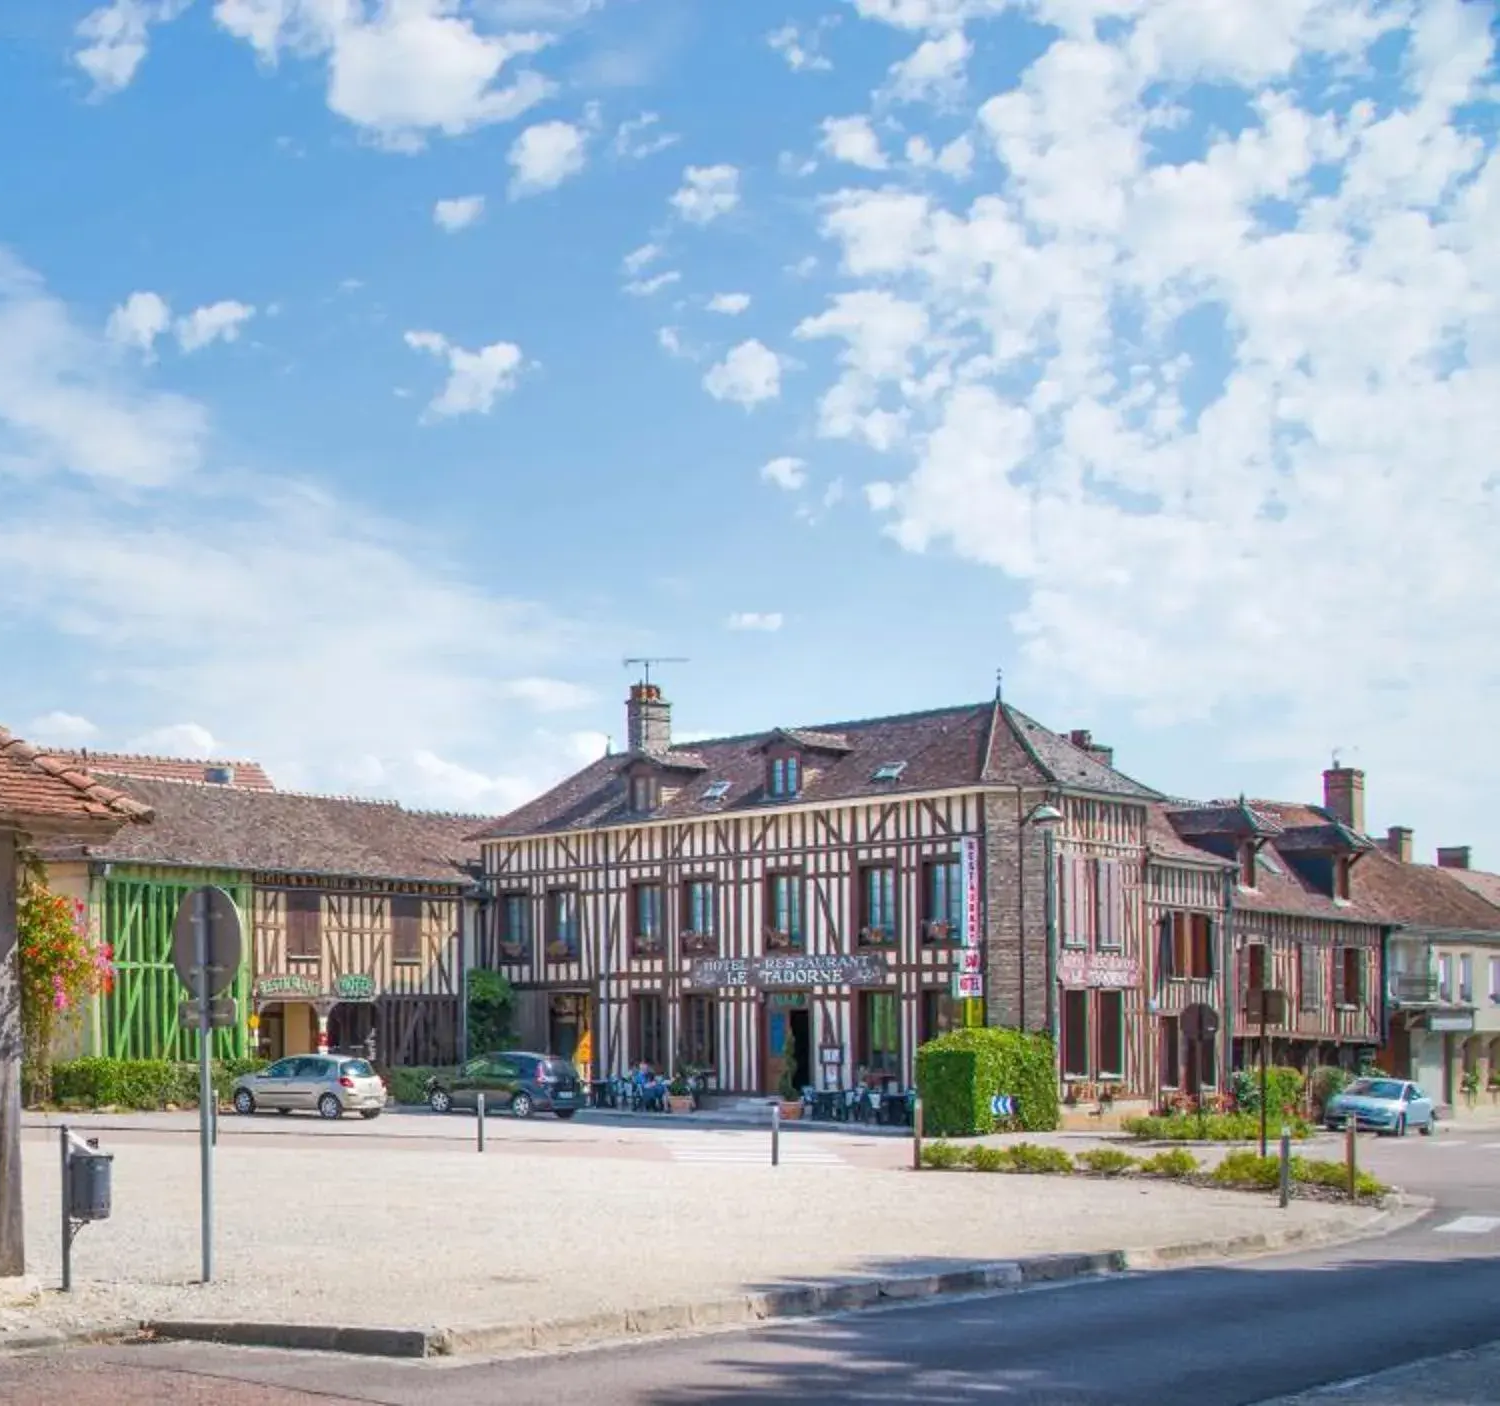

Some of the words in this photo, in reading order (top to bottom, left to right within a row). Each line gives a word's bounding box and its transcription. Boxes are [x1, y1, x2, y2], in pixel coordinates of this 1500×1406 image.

[765, 955, 869, 970] RESTAURANT
[727, 971, 748, 985] LE
[759, 969, 844, 984] TADORNE
